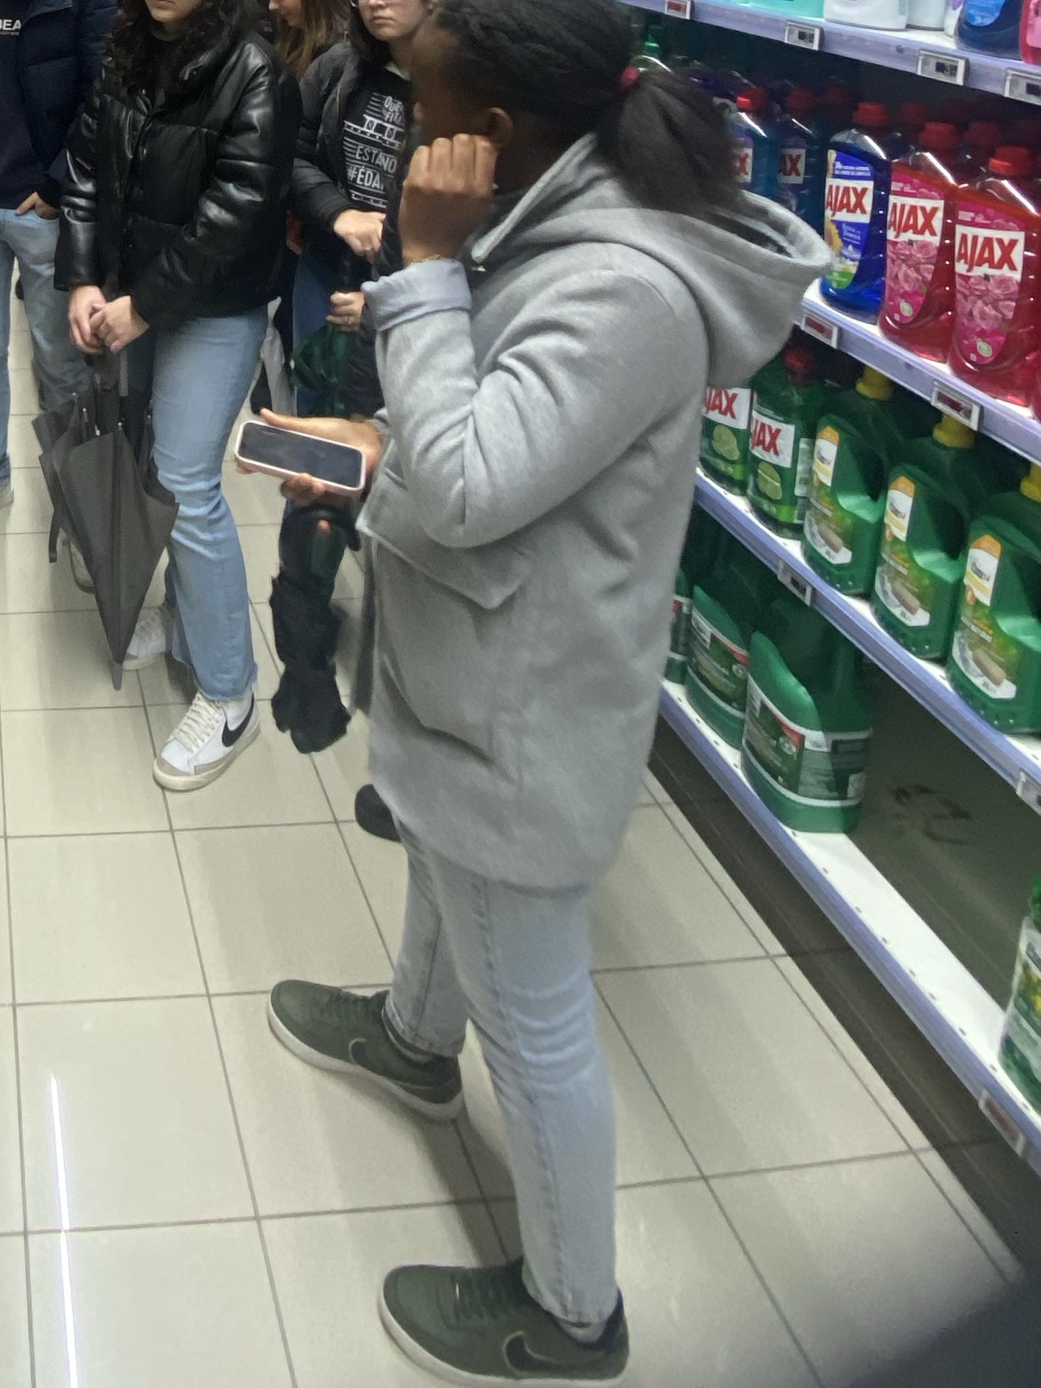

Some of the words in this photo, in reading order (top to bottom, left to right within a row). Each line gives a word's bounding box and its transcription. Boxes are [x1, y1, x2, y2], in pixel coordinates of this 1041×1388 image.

[826, 184, 869, 218] AJAX
[888, 203, 940, 238] AJAX
[957, 233, 1020, 272] AJAX
